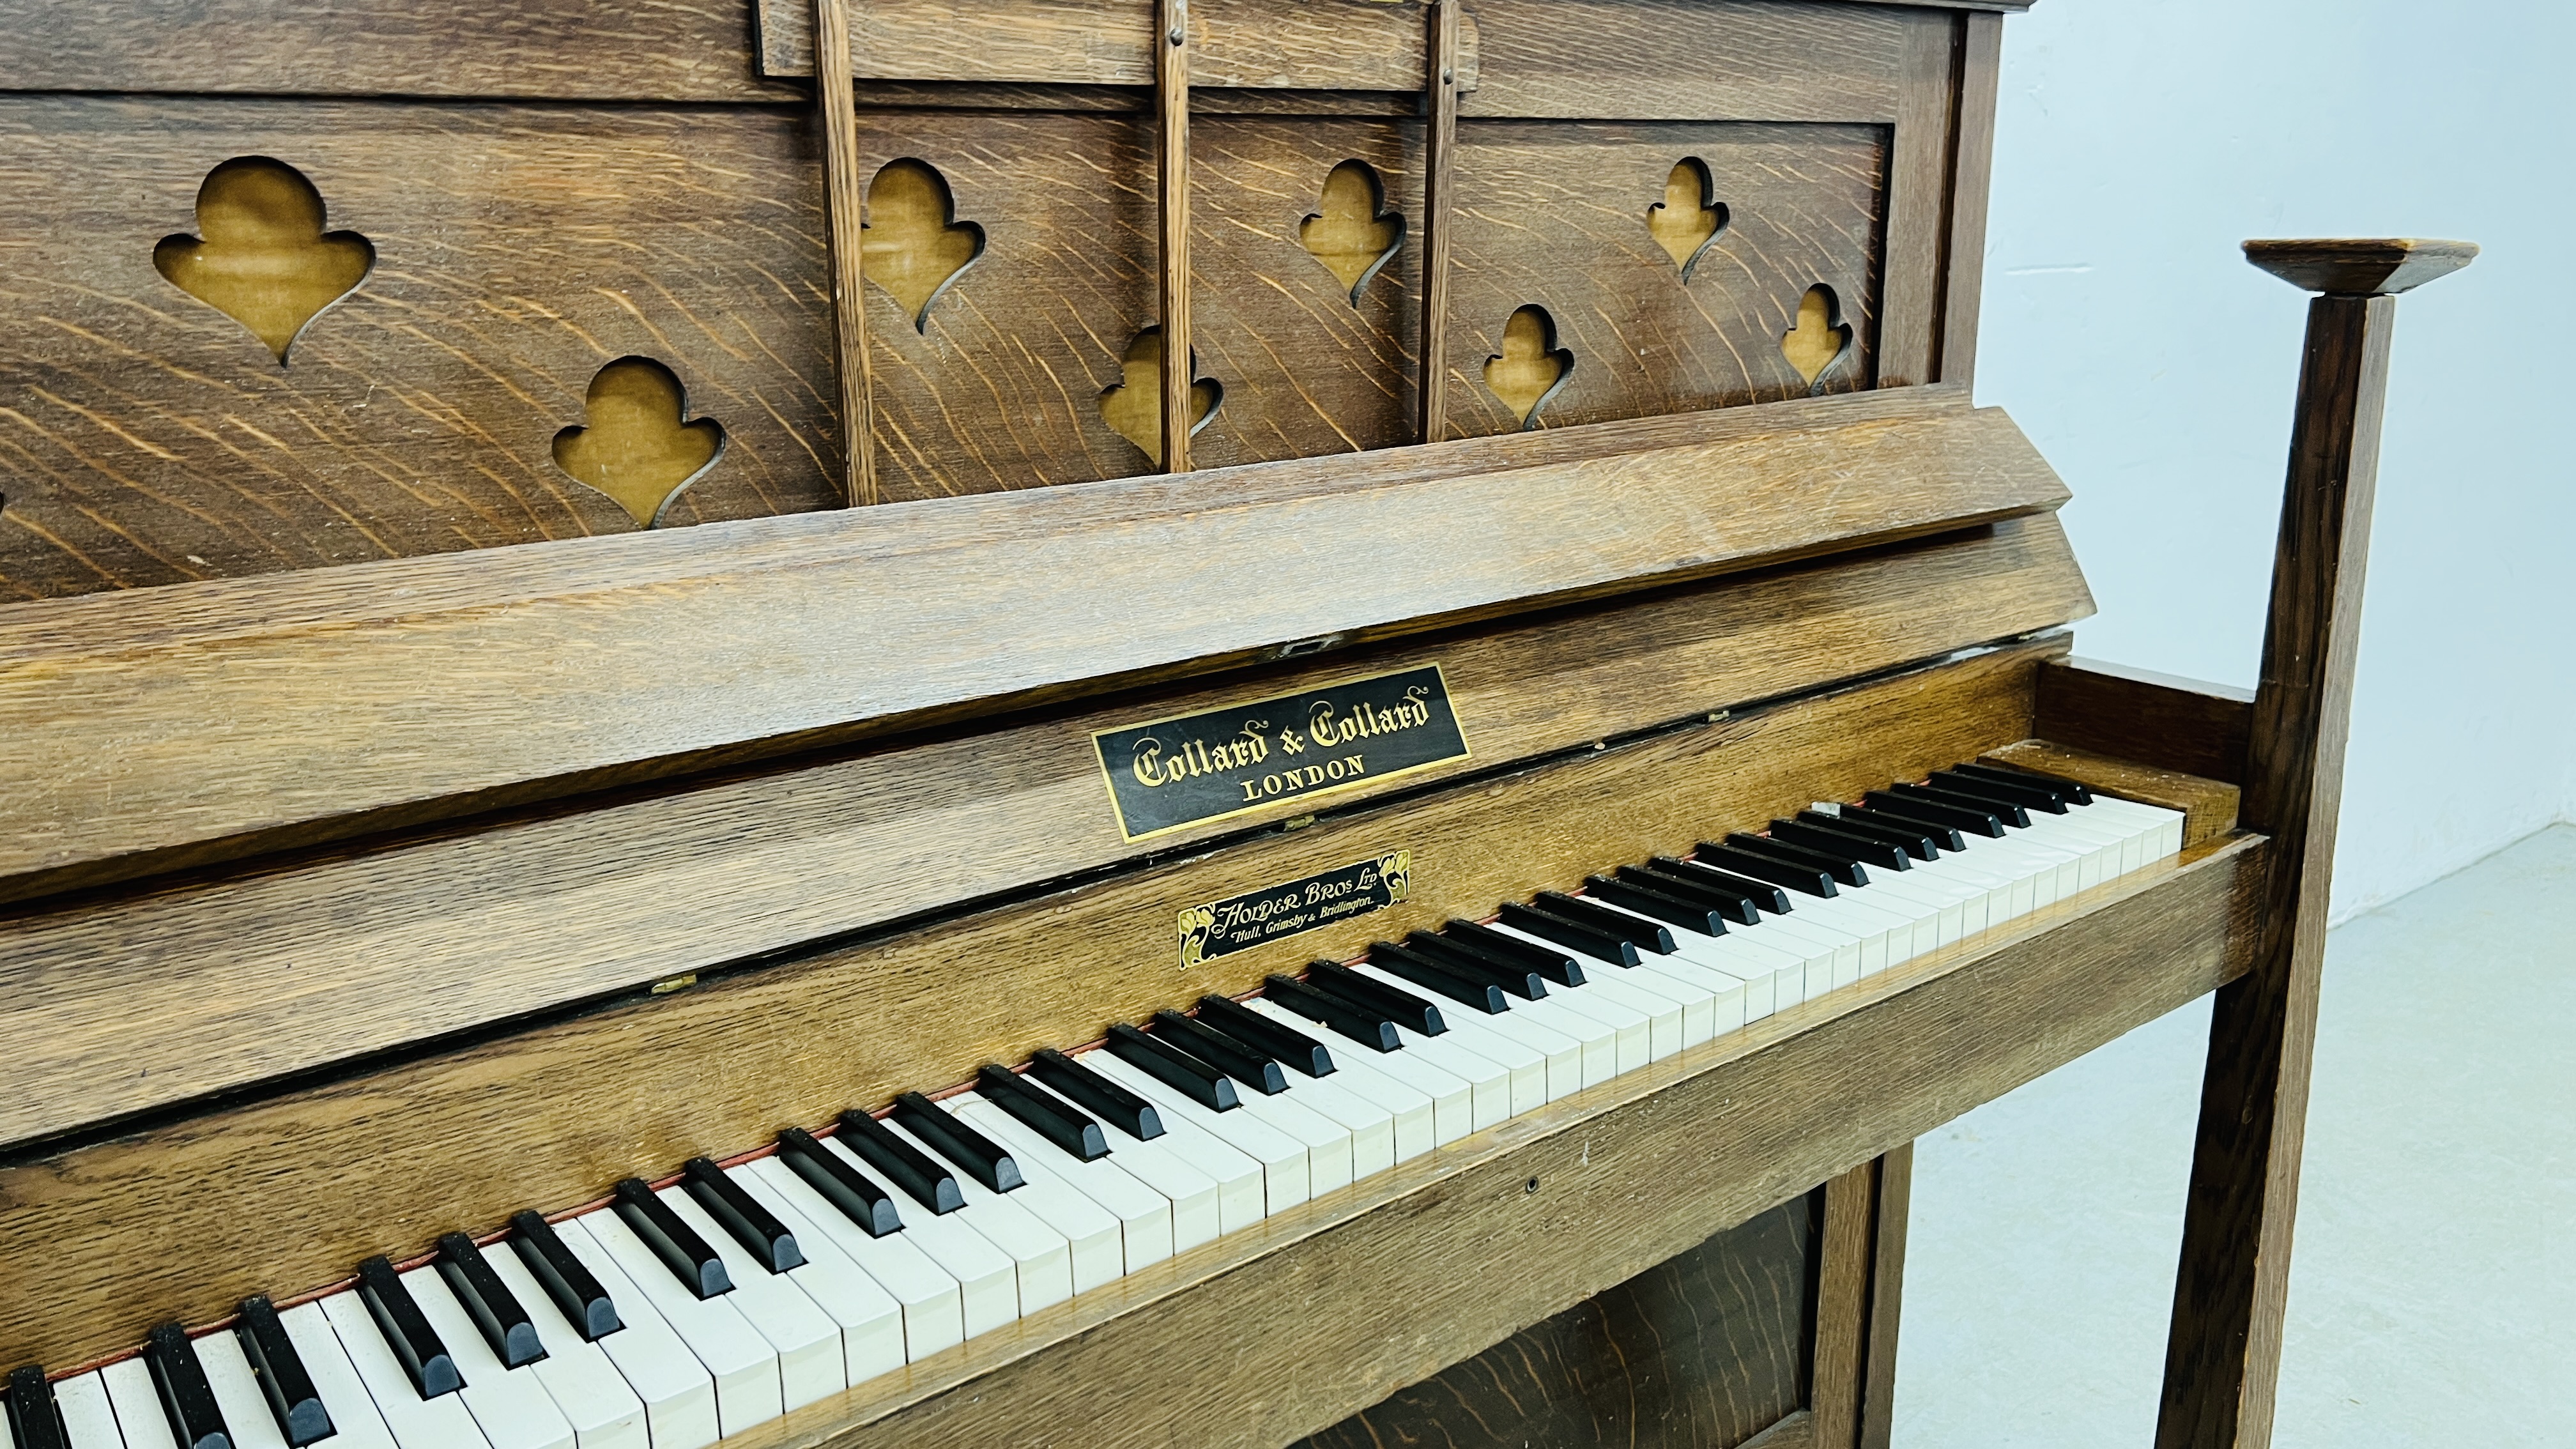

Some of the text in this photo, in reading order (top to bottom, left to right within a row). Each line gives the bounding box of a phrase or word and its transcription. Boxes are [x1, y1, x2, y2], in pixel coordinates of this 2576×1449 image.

[1133, 686, 1430, 787] Collard & Collard
[1239, 755, 1365, 802] LONDON
[1230, 924, 1261, 944] Hull,
[1265, 914, 1308, 933] Grimsby
[1308, 913, 1315, 922] &
